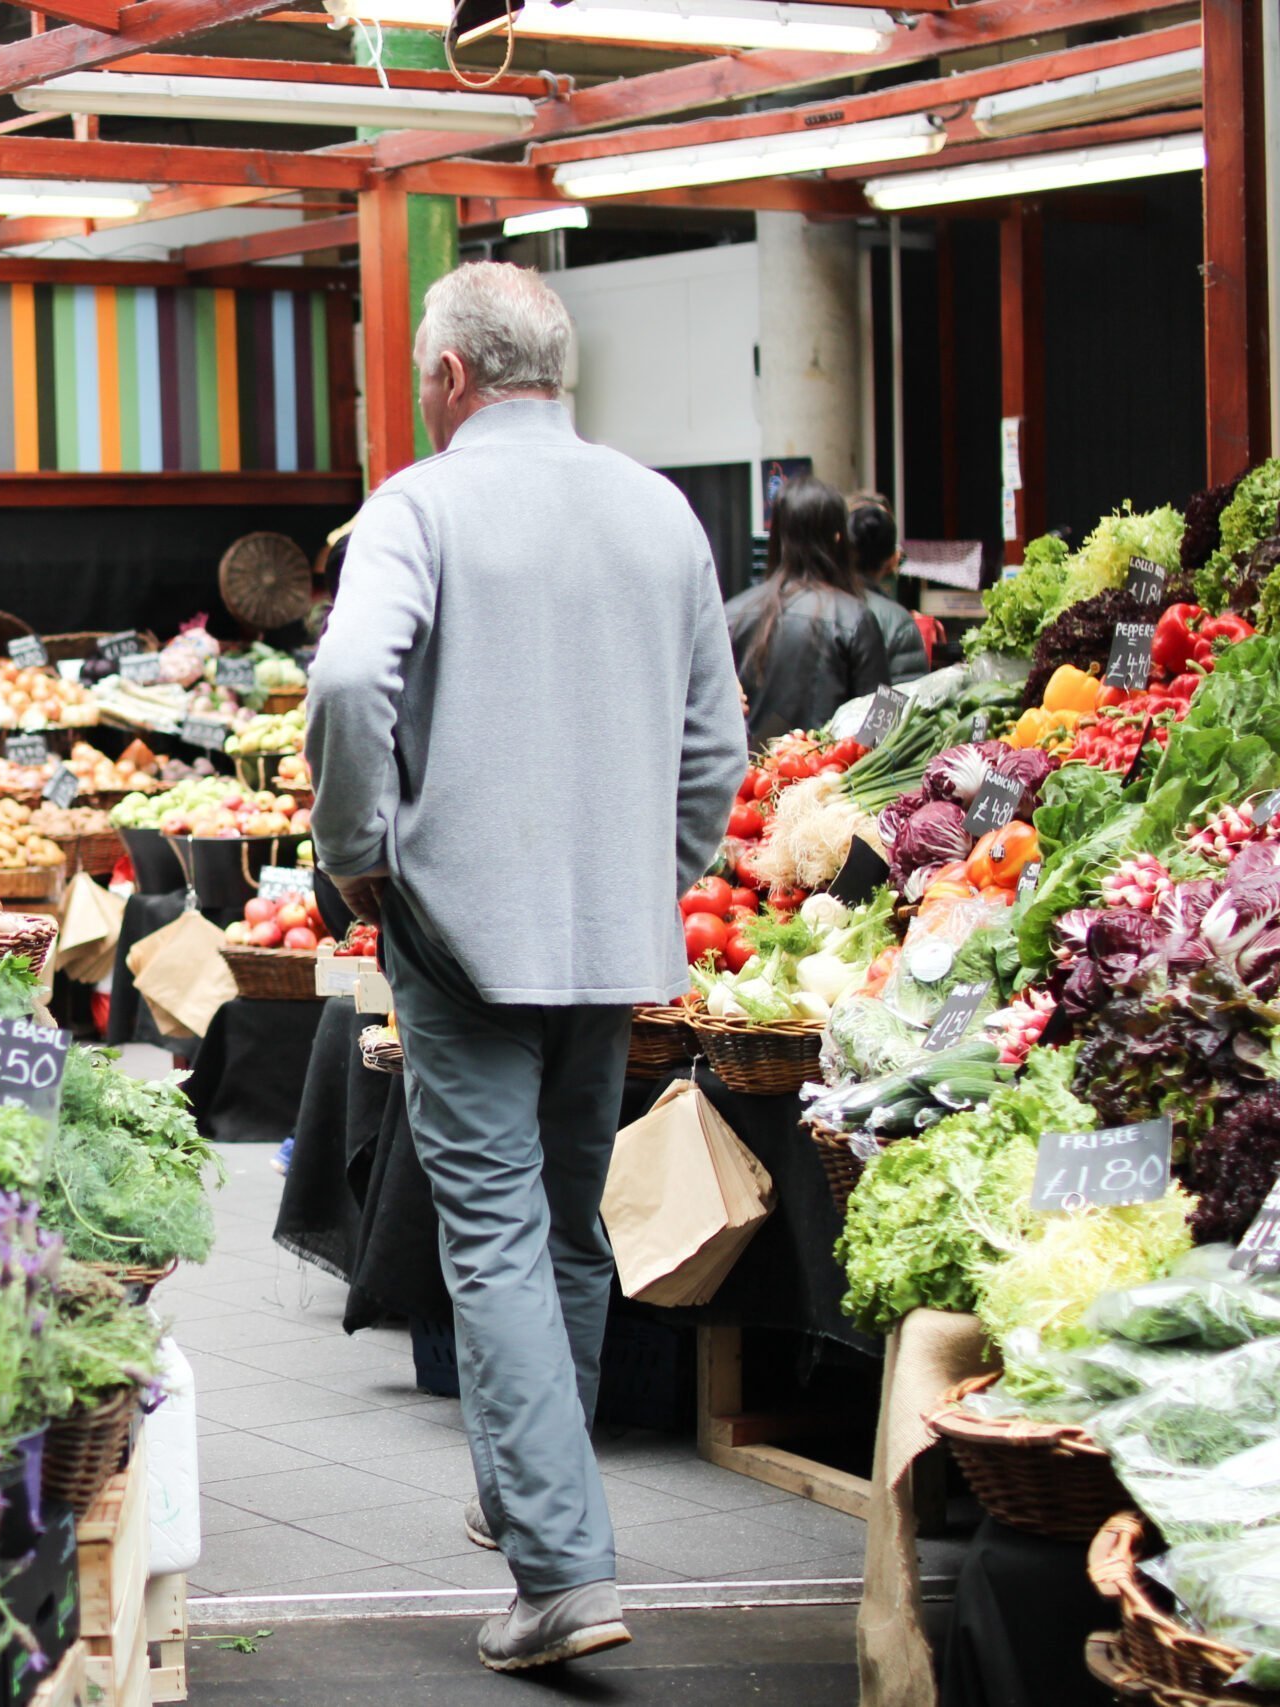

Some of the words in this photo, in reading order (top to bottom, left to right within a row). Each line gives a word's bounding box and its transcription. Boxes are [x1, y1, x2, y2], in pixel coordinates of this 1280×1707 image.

[1116, 622, 1156, 637] PEPPERS
[11, 1020, 68, 1051] BASIL
[1040, 1154, 1164, 1201] £1.80
